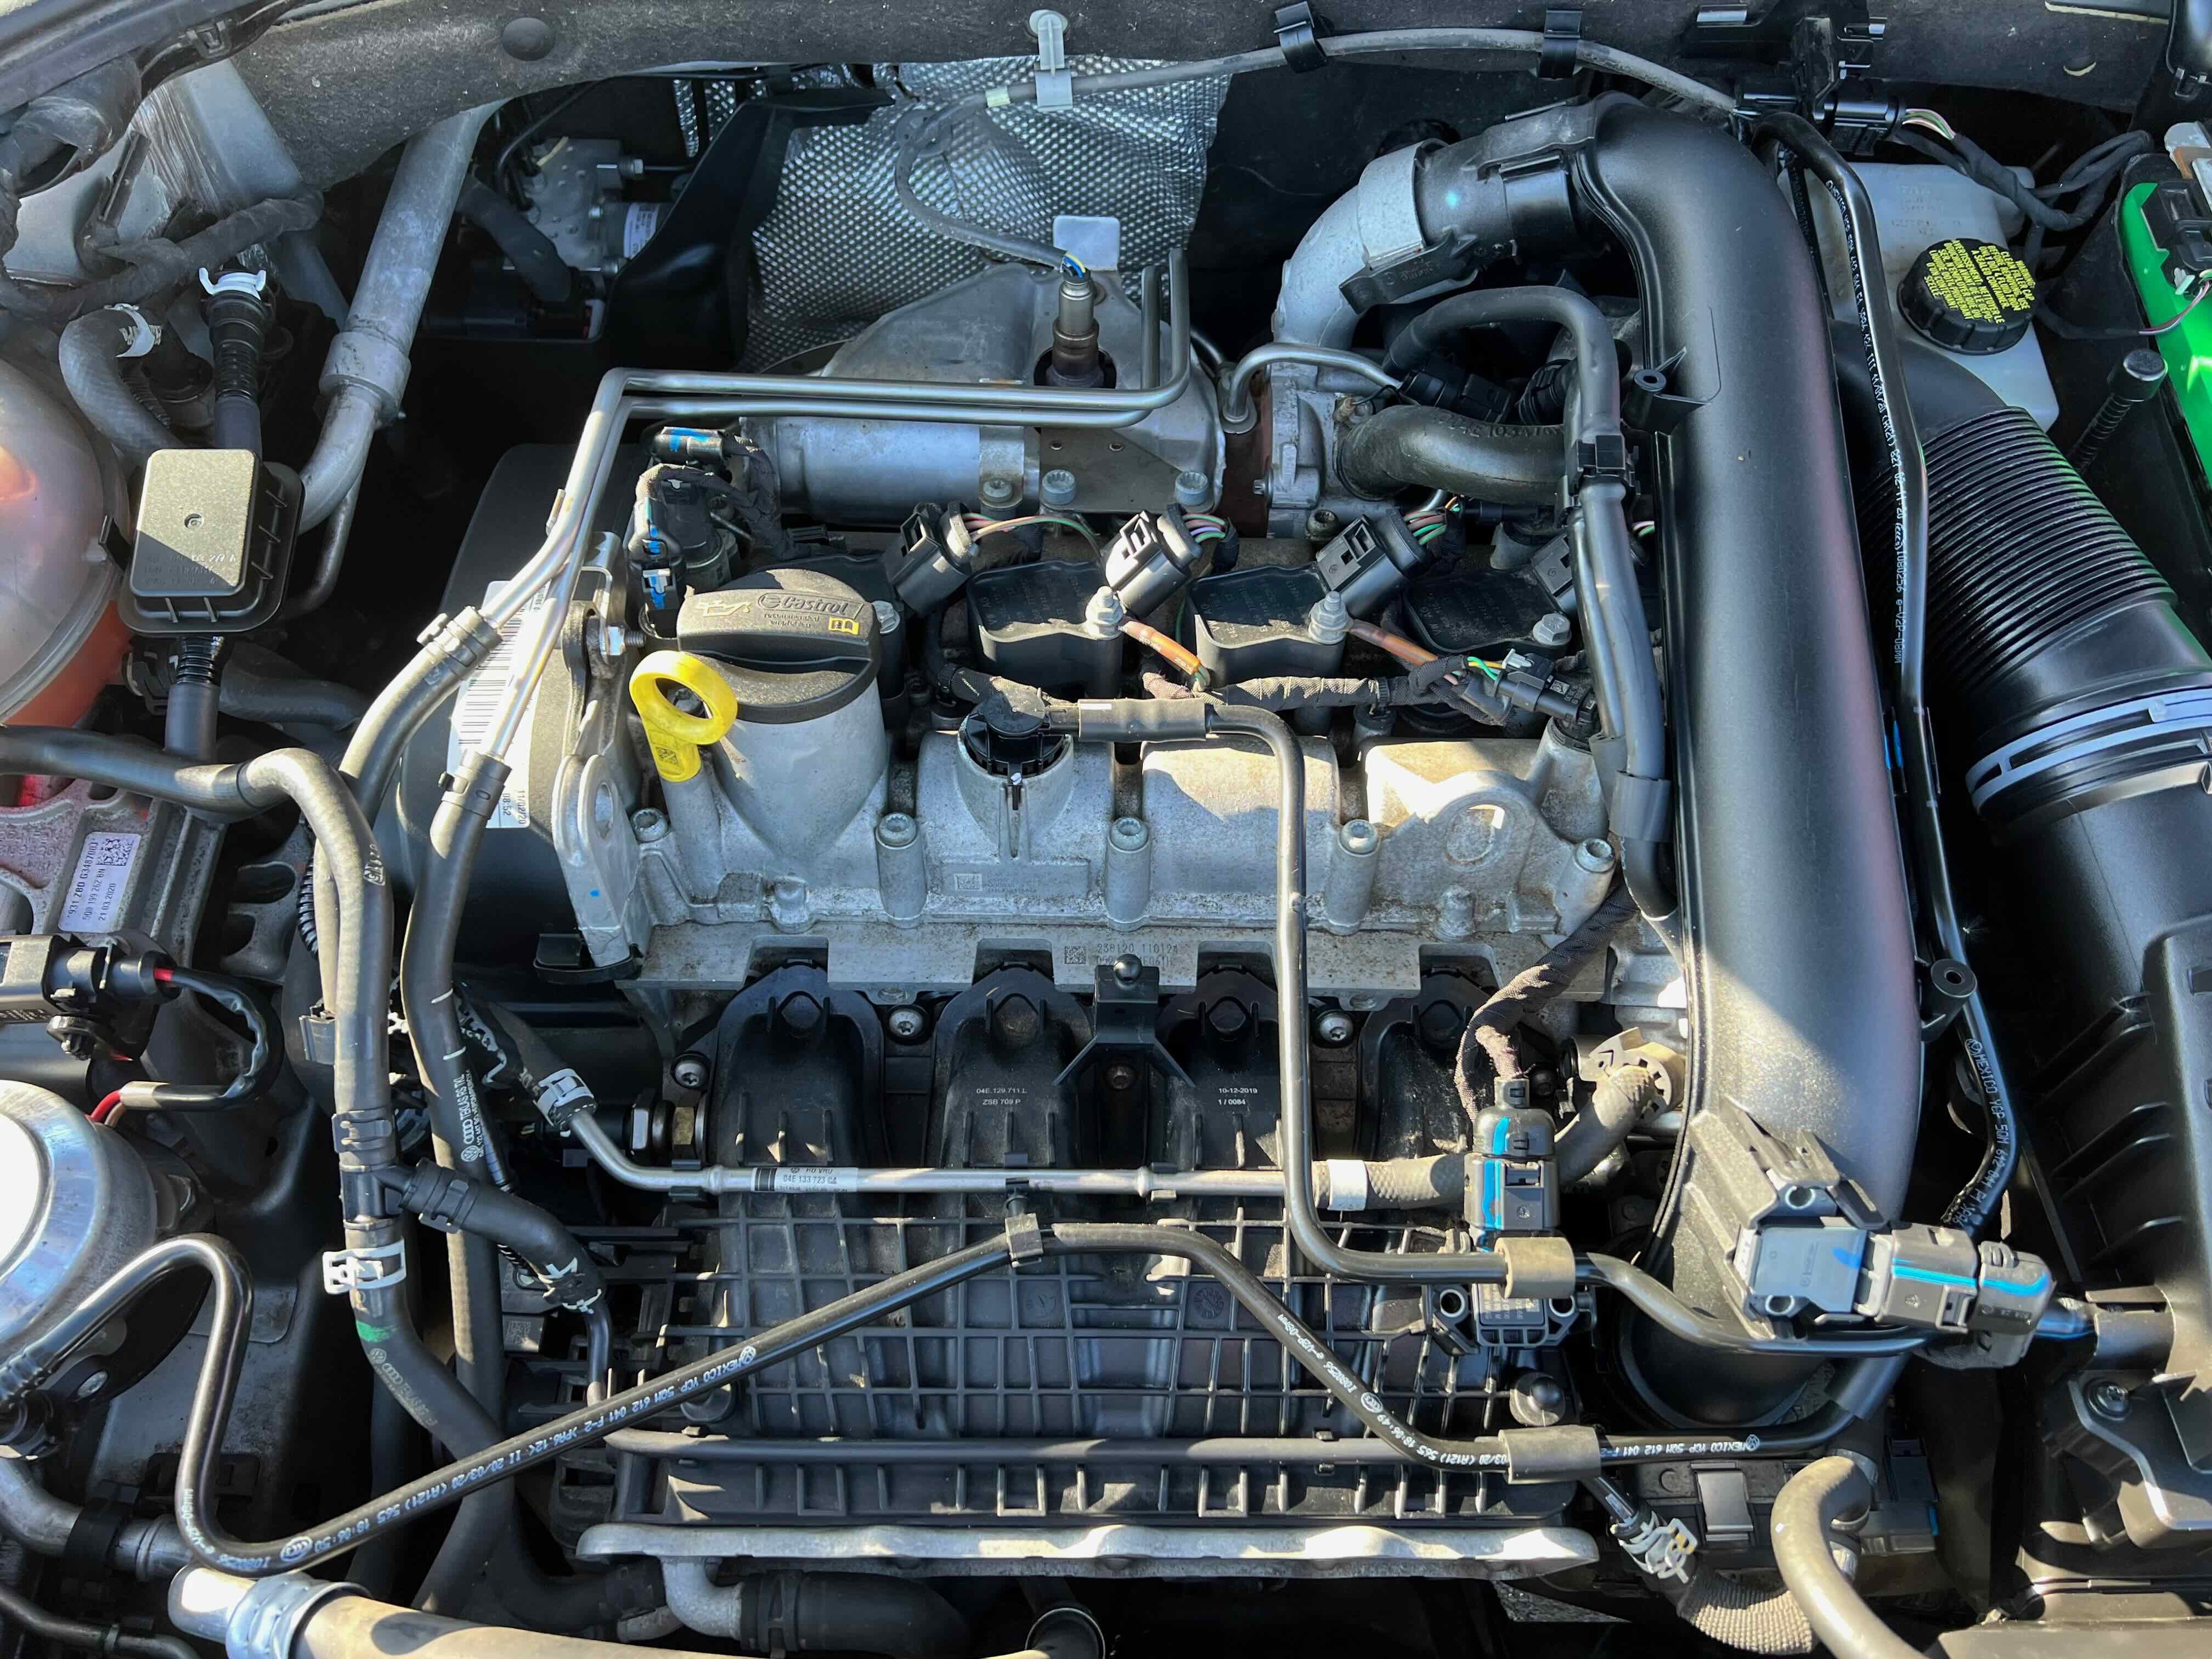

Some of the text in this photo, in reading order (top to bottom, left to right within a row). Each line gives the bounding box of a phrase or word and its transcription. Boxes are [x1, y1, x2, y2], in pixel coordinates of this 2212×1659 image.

[781, 596, 850, 616] Castrol
[503, 793, 511, 816] 08:52
[631, 1396, 650, 1412] 612
